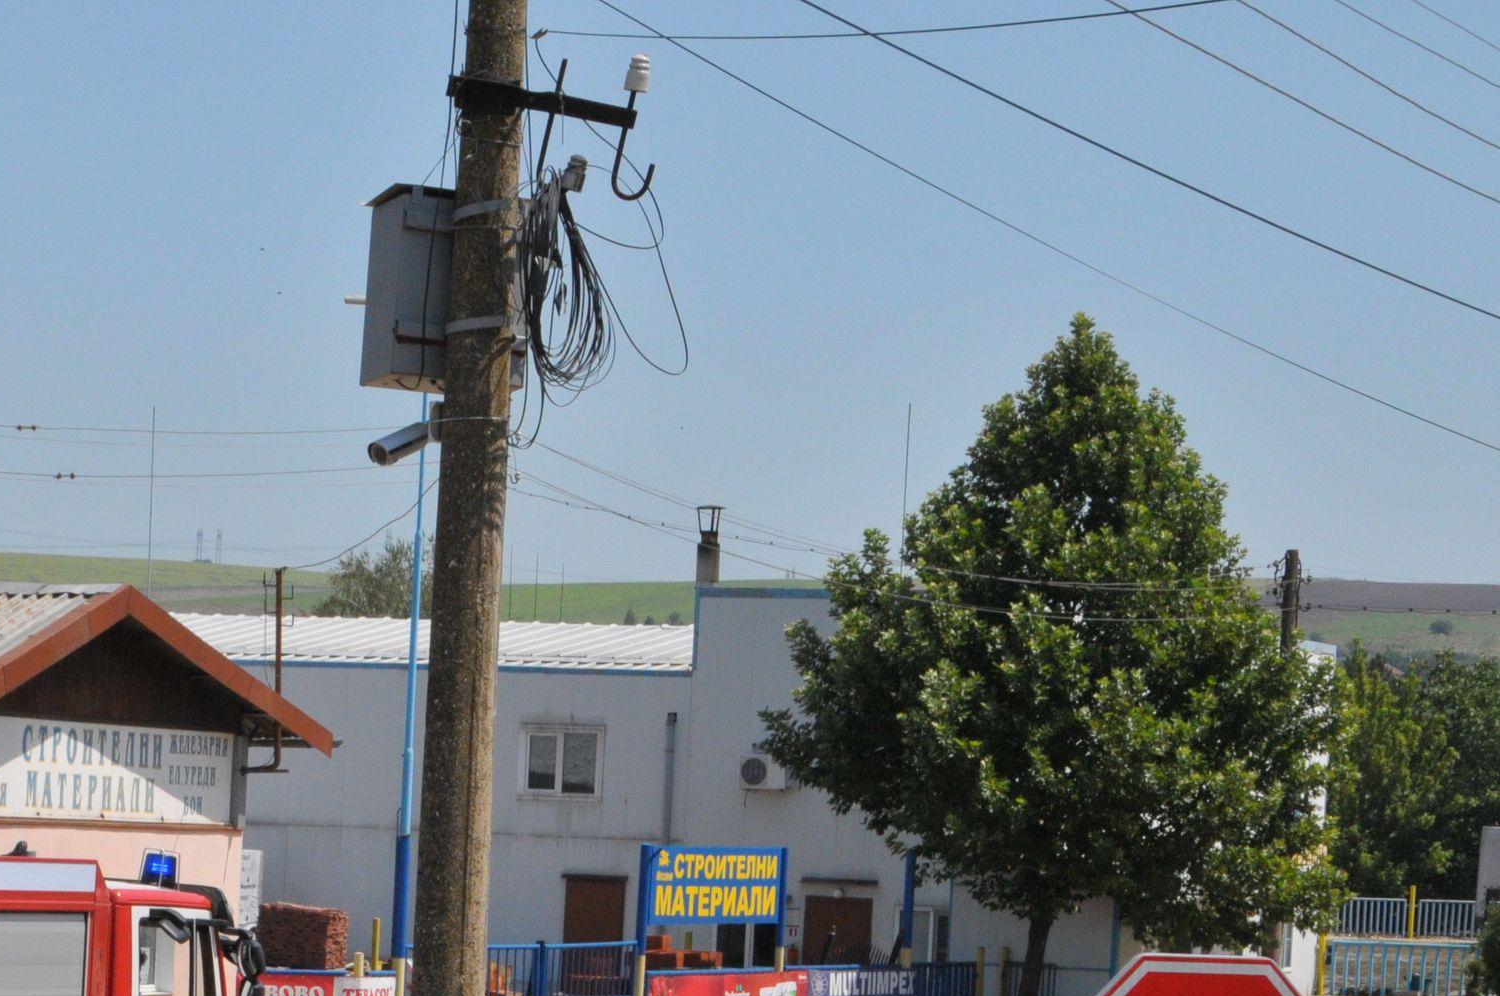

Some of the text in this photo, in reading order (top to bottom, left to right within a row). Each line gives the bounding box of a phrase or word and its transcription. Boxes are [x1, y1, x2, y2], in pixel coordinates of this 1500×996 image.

[22, 724, 163, 769] СТРОИТЕЛНИ
[26, 769, 155, 814] МАТЕРИАЛИ
[674, 853, 778, 880] СТРОИТЕЛНИ
[654, 884, 777, 917] МАТЕРИАЛИ
[829, 971, 915, 996] MULTIIMPEX
